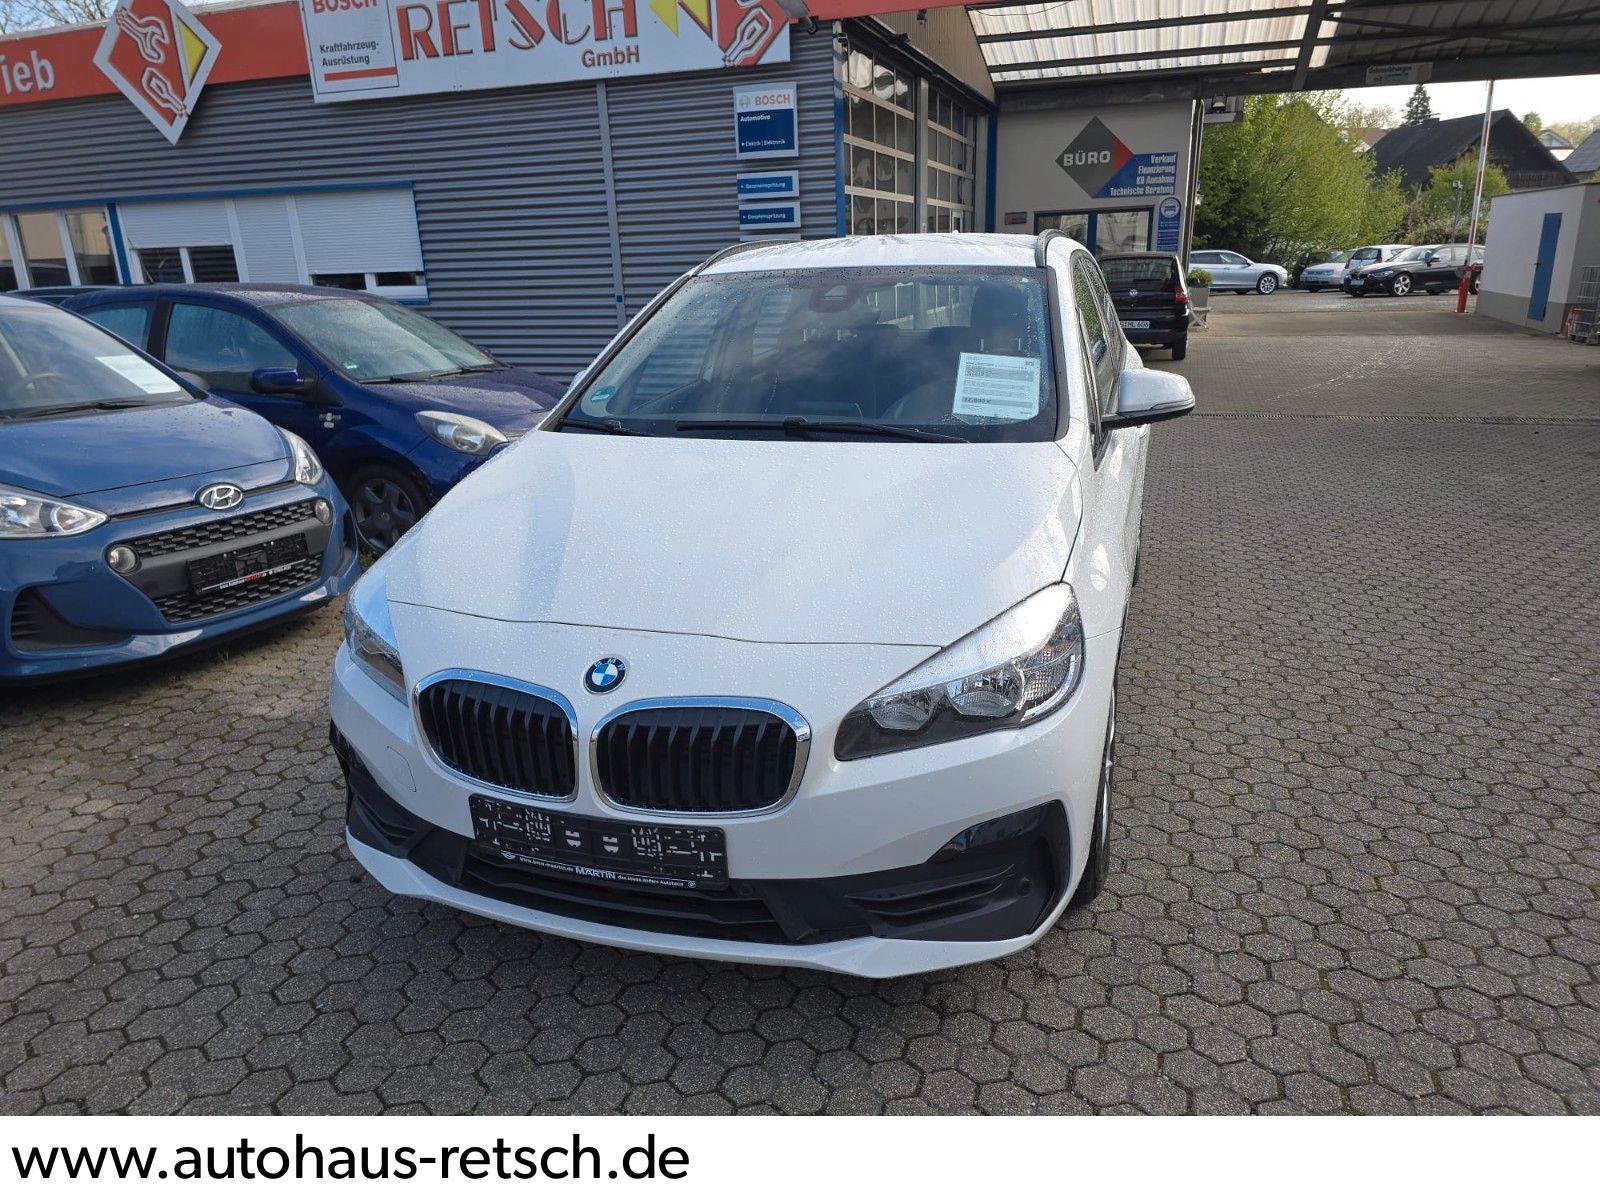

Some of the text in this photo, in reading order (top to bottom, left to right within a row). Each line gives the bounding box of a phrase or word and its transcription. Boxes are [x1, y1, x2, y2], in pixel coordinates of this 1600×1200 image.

[397, 0, 638, 60] RETSCH
[320, 40, 379, 55] Kraftfahrzeug-
[322, 55, 370, 67] Ausrüstung
[581, 44, 640, 68] GmbH
[754, 94, 791, 107] BOSCH
[740, 114, 771, 123] Automotive
[1063, 150, 1111, 166] BÜRO
[1151, 154, 1177, 164] Verkauf
[1138, 165, 1175, 175] Finanzierung
[575, 865, 616, 880] MARTIN
